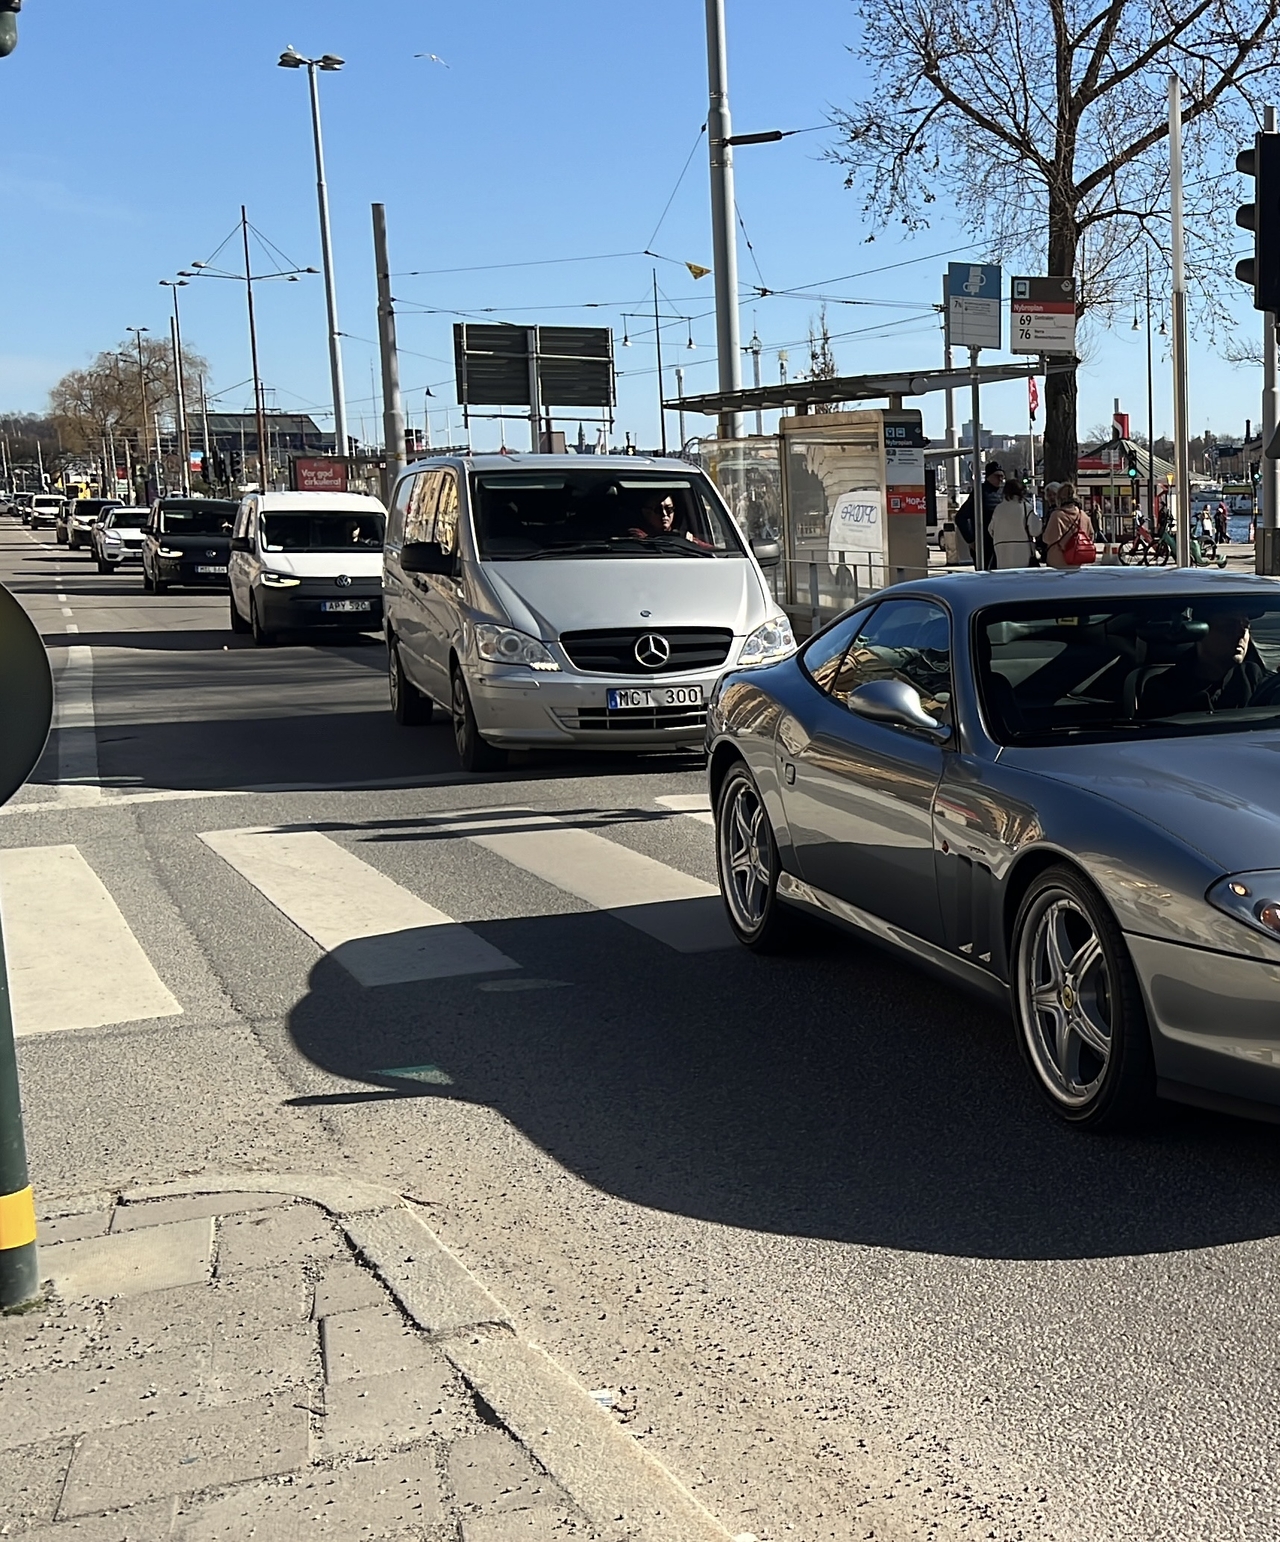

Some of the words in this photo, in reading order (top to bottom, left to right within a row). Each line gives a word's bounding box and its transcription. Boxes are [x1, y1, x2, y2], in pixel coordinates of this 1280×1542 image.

[1013, 303, 1044, 313] Nybroplan
[1019, 315, 1032, 326] 69
[1019, 328, 1031, 340] 76
[885, 438, 913, 447] Nybroplan
[301, 468, 315, 478] Var
[317, 468, 334, 480] god
[304, 476, 341, 486] cirkulera!
[328, 601, 346, 610] APY
[619, 690, 651, 706] MCT
[665, 688, 698, 704] 300
